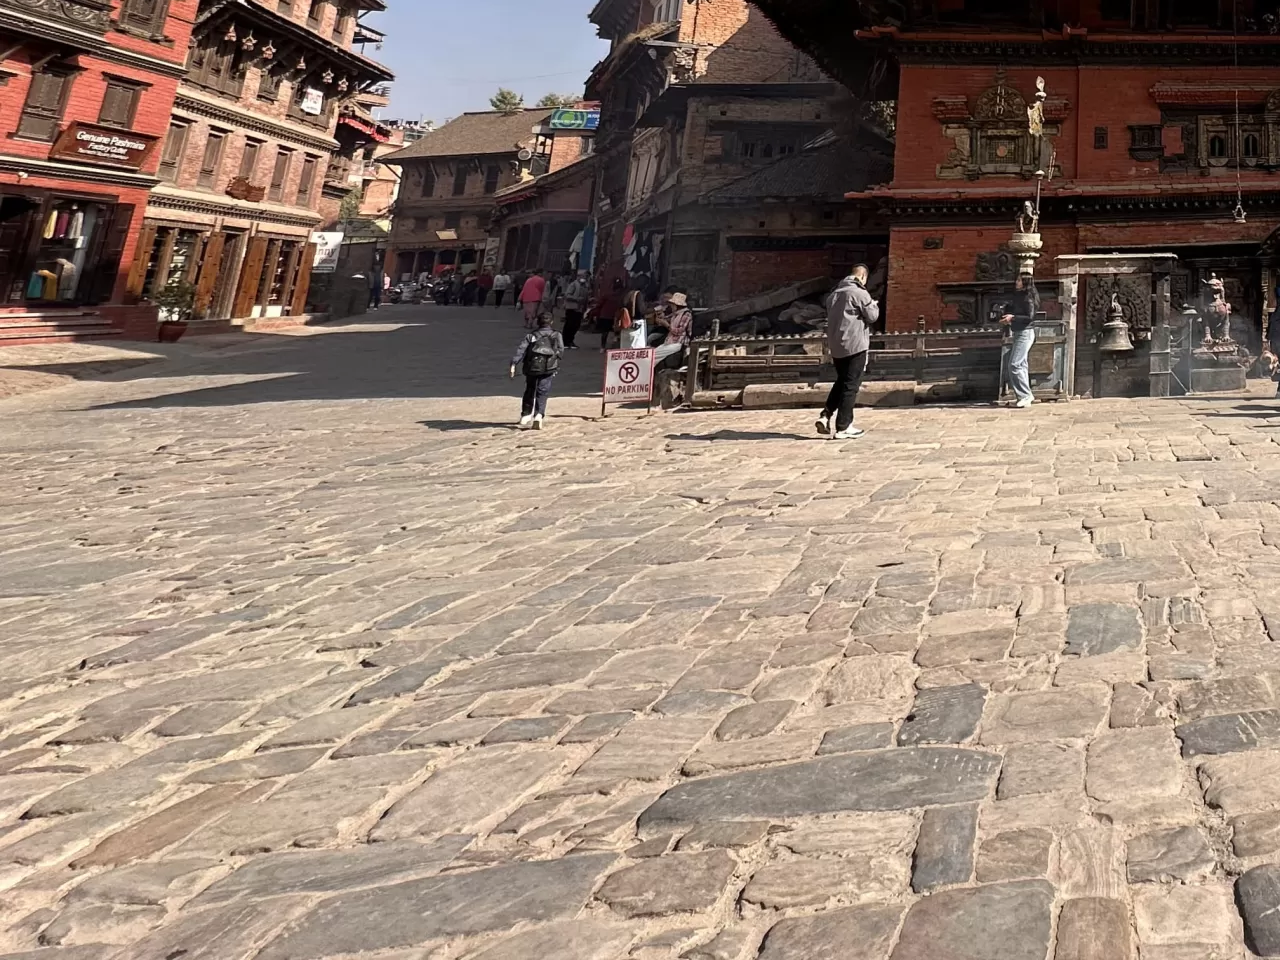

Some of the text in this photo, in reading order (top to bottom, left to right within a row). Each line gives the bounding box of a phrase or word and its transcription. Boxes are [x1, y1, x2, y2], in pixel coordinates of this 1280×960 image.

[76, 131, 146, 150] Genuine Pashmina
[88, 142, 110, 152] Factory
[110, 145, 128, 155] Outlet
[611, 350, 649, 360] HERITAGE AREA
[605, 383, 649, 395] NO PARKING
